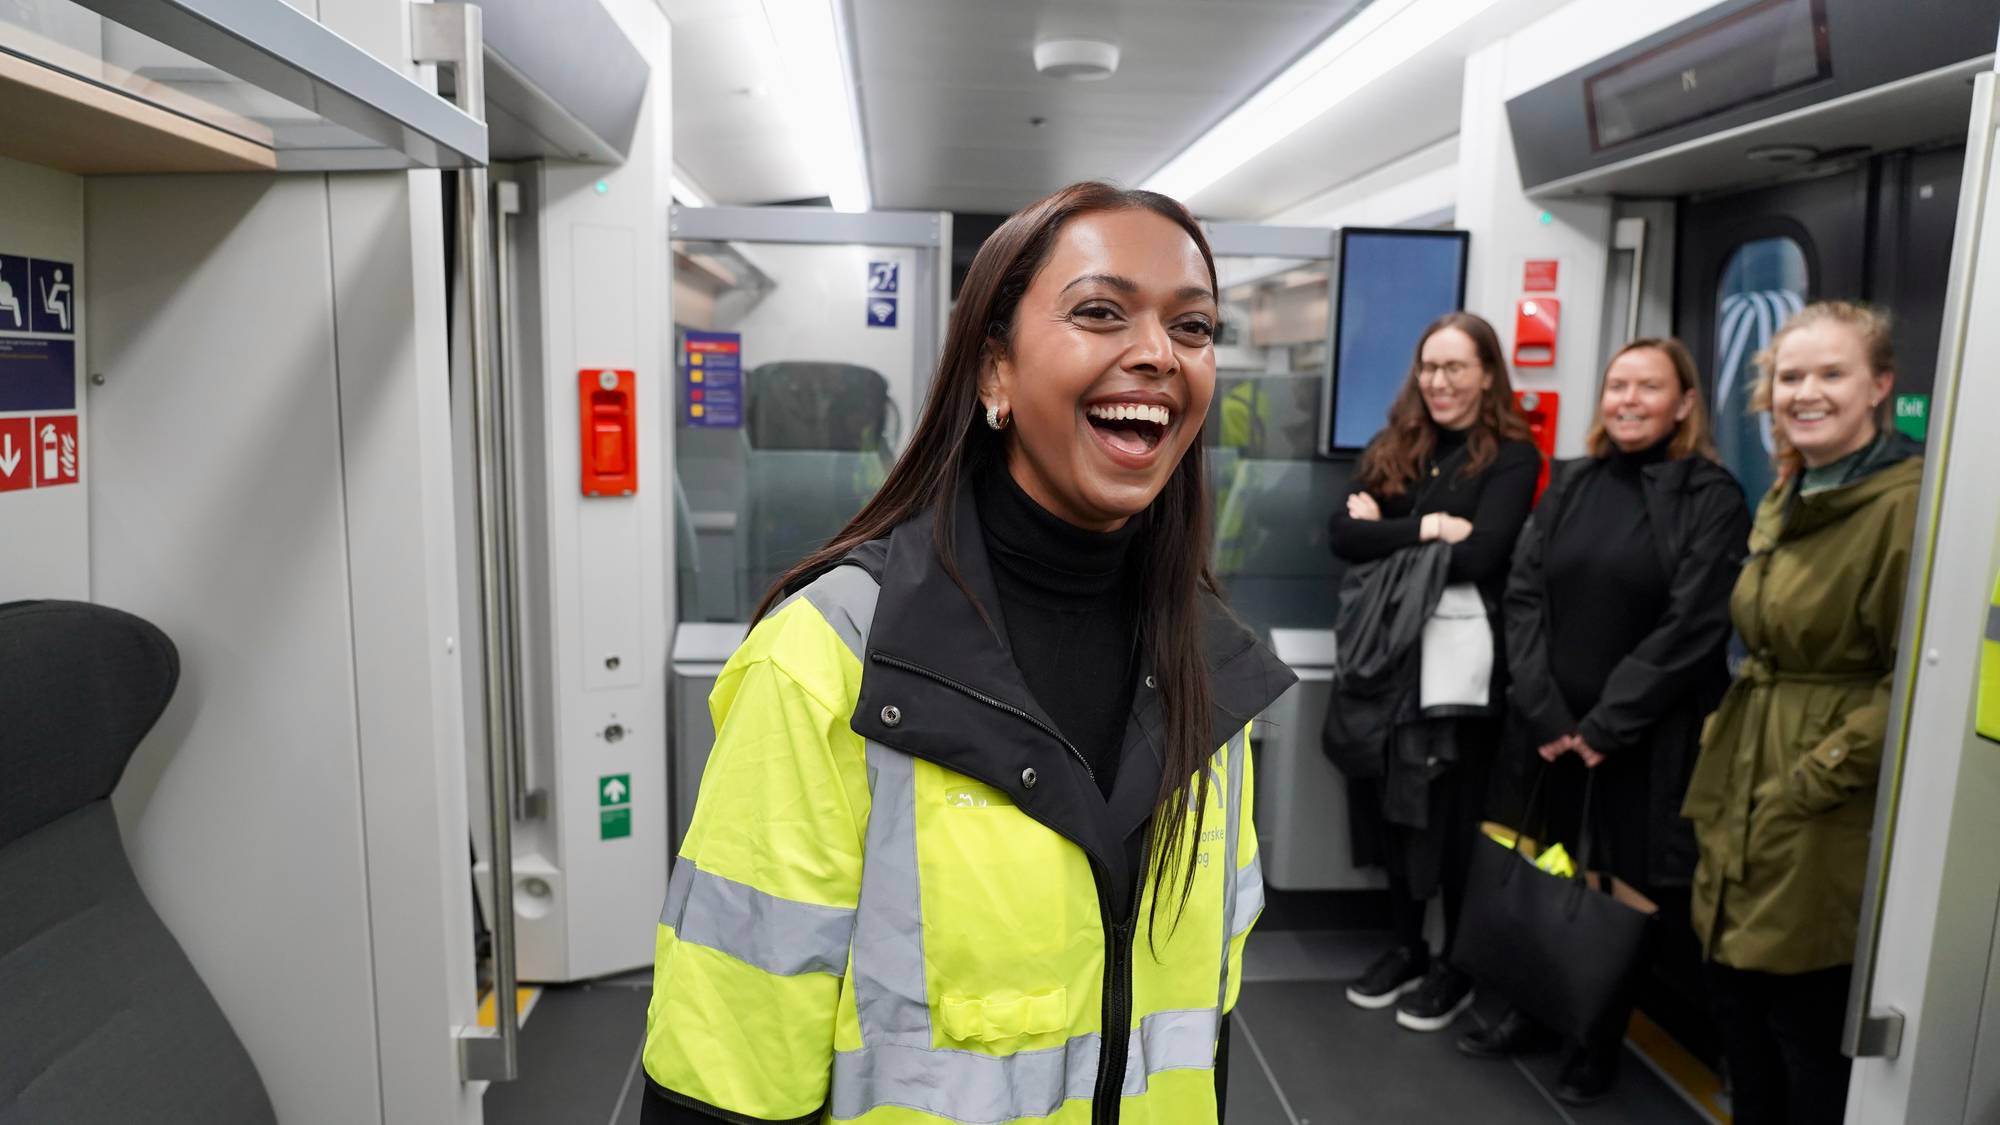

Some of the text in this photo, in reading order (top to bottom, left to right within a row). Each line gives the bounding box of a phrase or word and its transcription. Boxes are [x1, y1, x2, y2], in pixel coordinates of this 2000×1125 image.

[1896, 396, 1923, 417] Exit
[1199, 826, 1224, 842] orske
[1197, 852, 1209, 868] og
